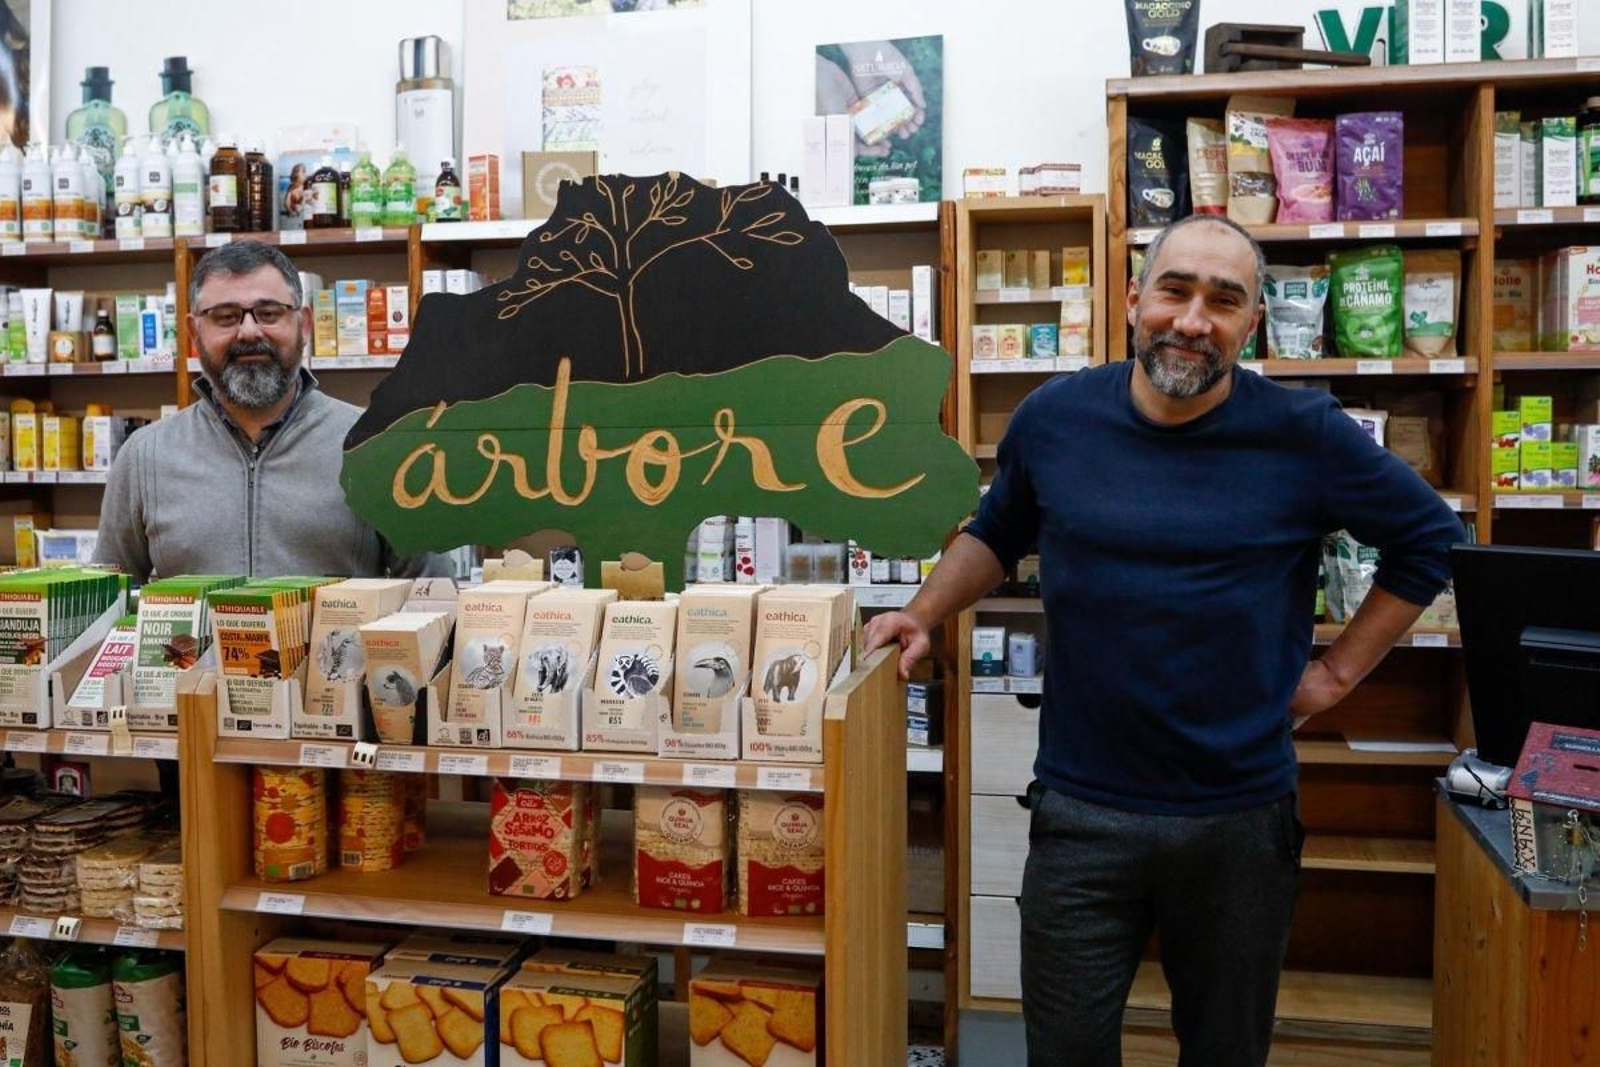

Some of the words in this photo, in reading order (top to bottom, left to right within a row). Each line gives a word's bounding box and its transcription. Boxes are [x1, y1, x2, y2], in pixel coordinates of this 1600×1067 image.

[1353, 141, 1386, 167] AÇAÍ
[1343, 279, 1389, 294] PROTEÍNA
[1493, 274, 1521, 286] olle
[392, 356, 926, 508] árbore
[143, 622, 172, 636] NOIR
[104, 644, 132, 655] LAIT
[222, 646, 250, 661] 74%
[749, 742, 772, 752] 100%
[280, 1037, 300, 1050] Bio
